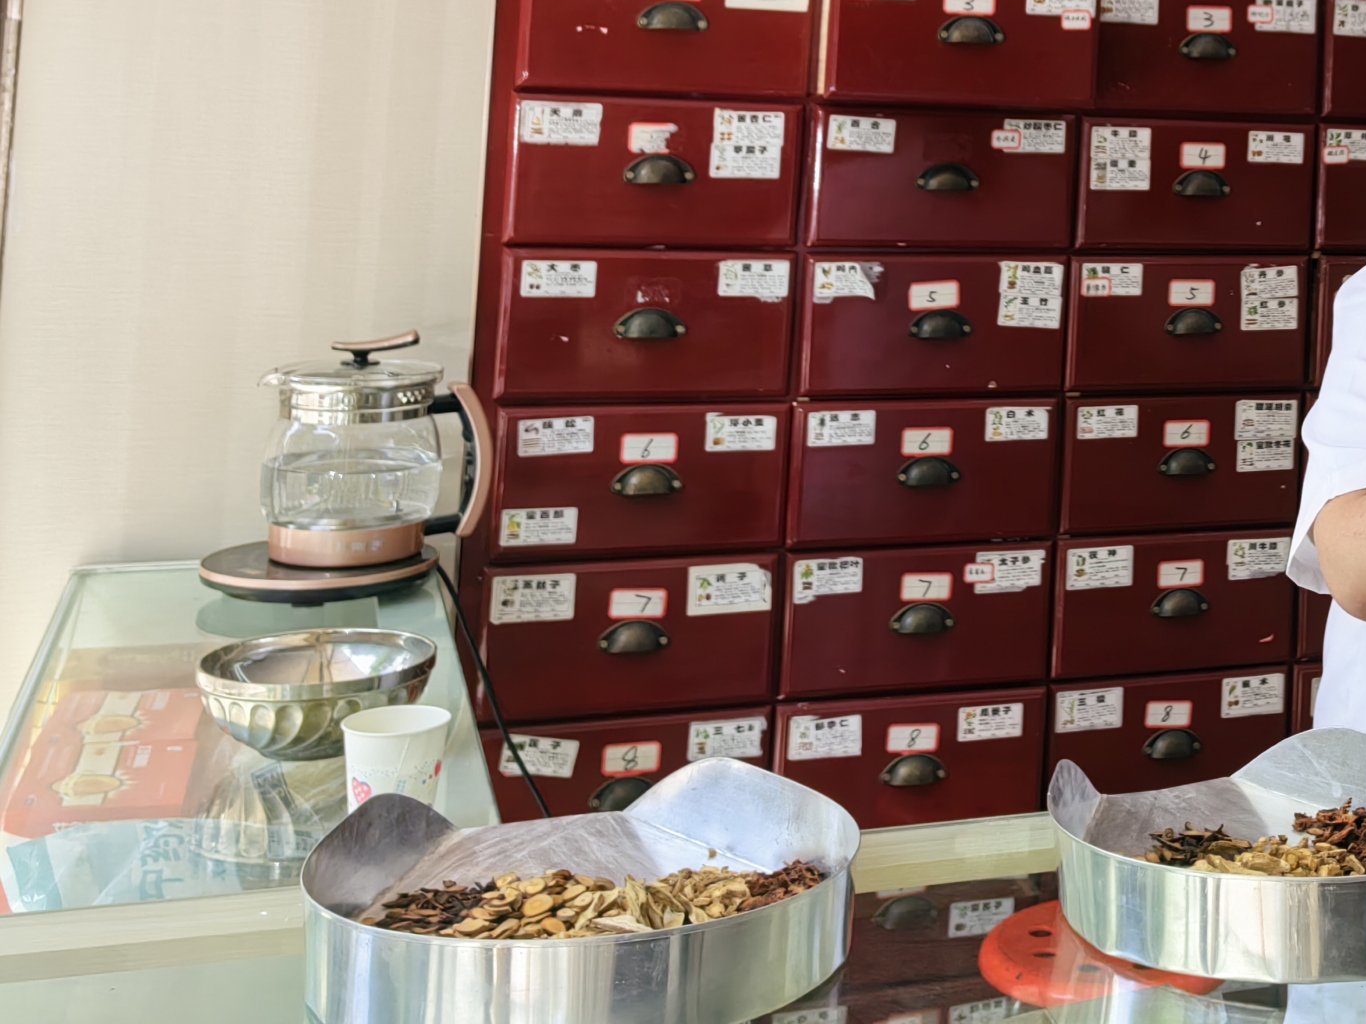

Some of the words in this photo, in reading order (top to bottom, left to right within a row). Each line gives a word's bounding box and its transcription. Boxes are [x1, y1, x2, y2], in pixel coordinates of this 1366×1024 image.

[1203, 11, 1215, 28] 3
[1198, 147, 1212, 165] 4
[926, 290, 937, 303] 5
[1185, 286, 1200, 301] 5
[918, 432, 932, 451] 6
[1180, 424, 1193, 440] 6
[640, 438, 654, 459] 6
[1175, 566, 1188, 581] 7
[918, 579, 933, 598] 7
[634, 593, 653, 613] 7
[1160, 704, 1174, 723] 8
[906, 728, 922, 749] 8
[621, 746, 639, 772] 8
